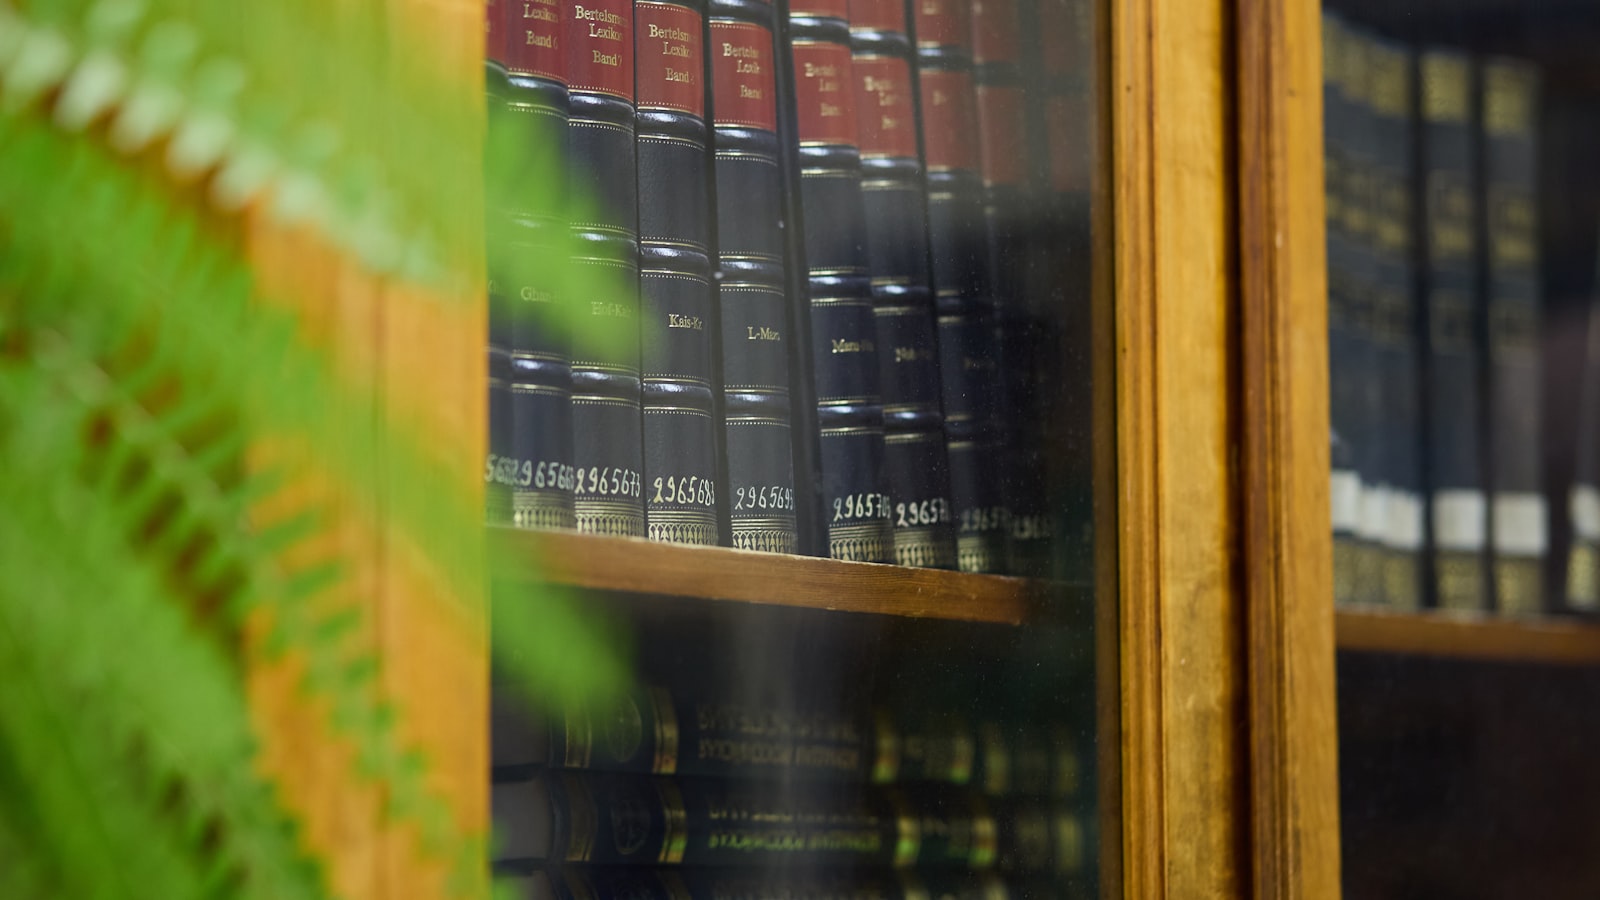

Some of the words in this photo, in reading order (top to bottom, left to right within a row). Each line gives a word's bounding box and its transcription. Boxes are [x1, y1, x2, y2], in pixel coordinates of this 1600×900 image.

[525, 29, 553, 49] Band
[592, 49, 618, 67] Band
[664, 67, 690, 84] Band
[574, 466, 641, 498] 2965673
